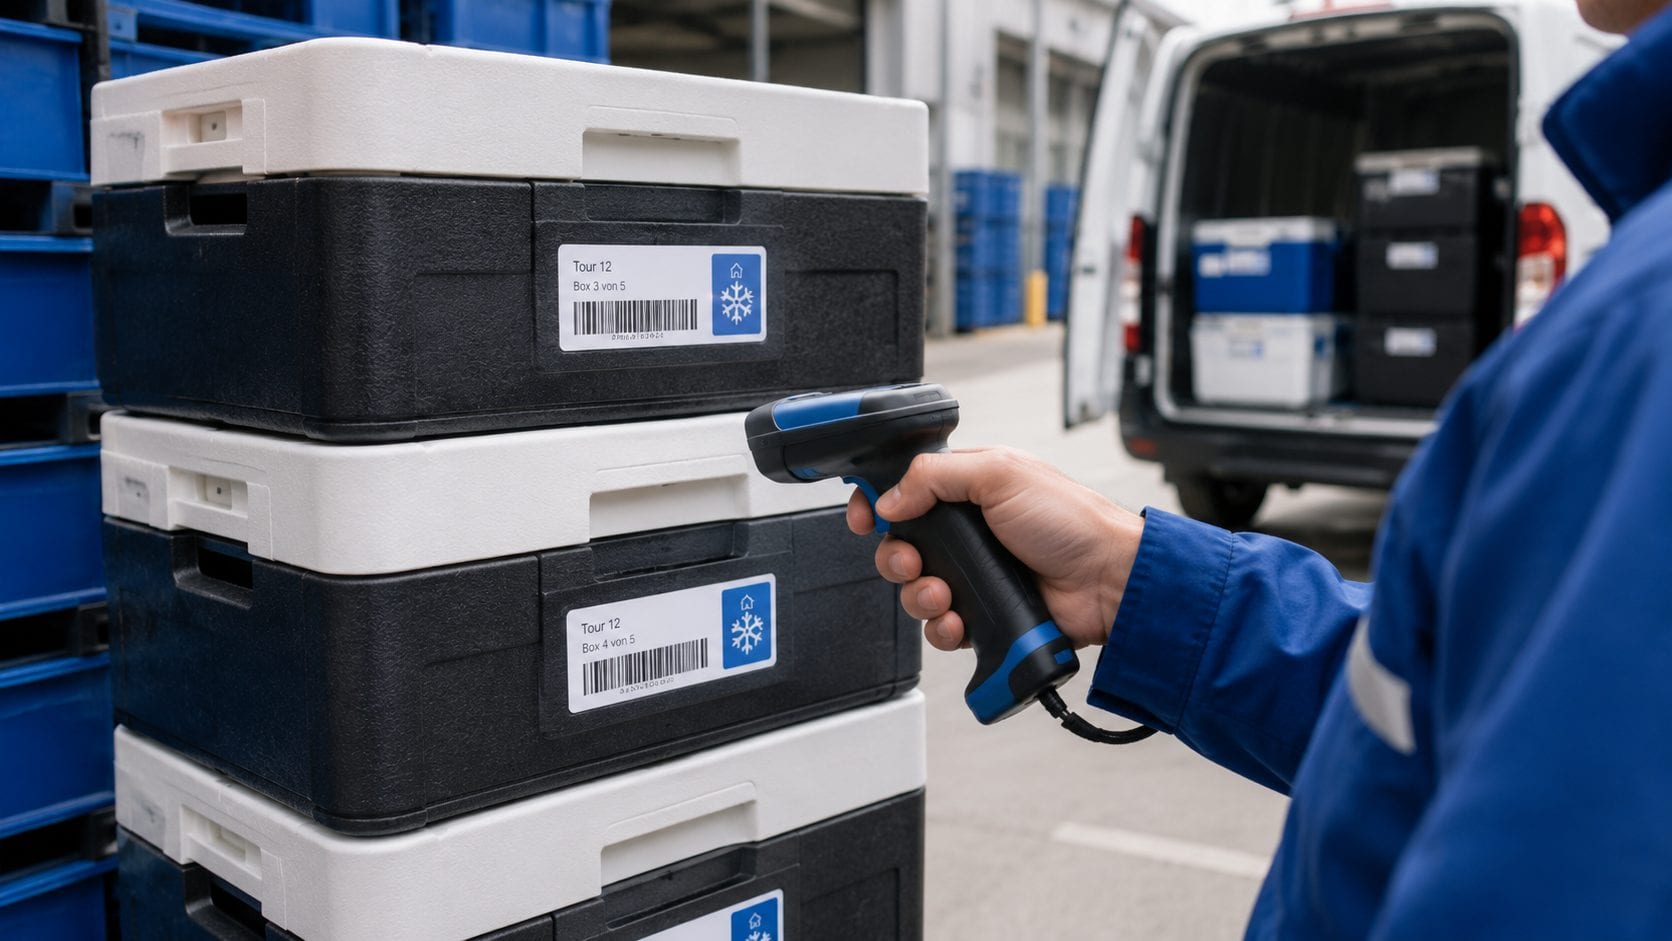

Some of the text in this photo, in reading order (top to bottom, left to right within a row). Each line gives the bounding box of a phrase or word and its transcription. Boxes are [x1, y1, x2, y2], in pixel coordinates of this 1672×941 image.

[573, 261, 612, 272] Tour 12
[573, 281, 626, 291] Box 3 von 5
[581, 617, 620, 634] Tour 12
[582, 634, 635, 653] Box 4 von 5
